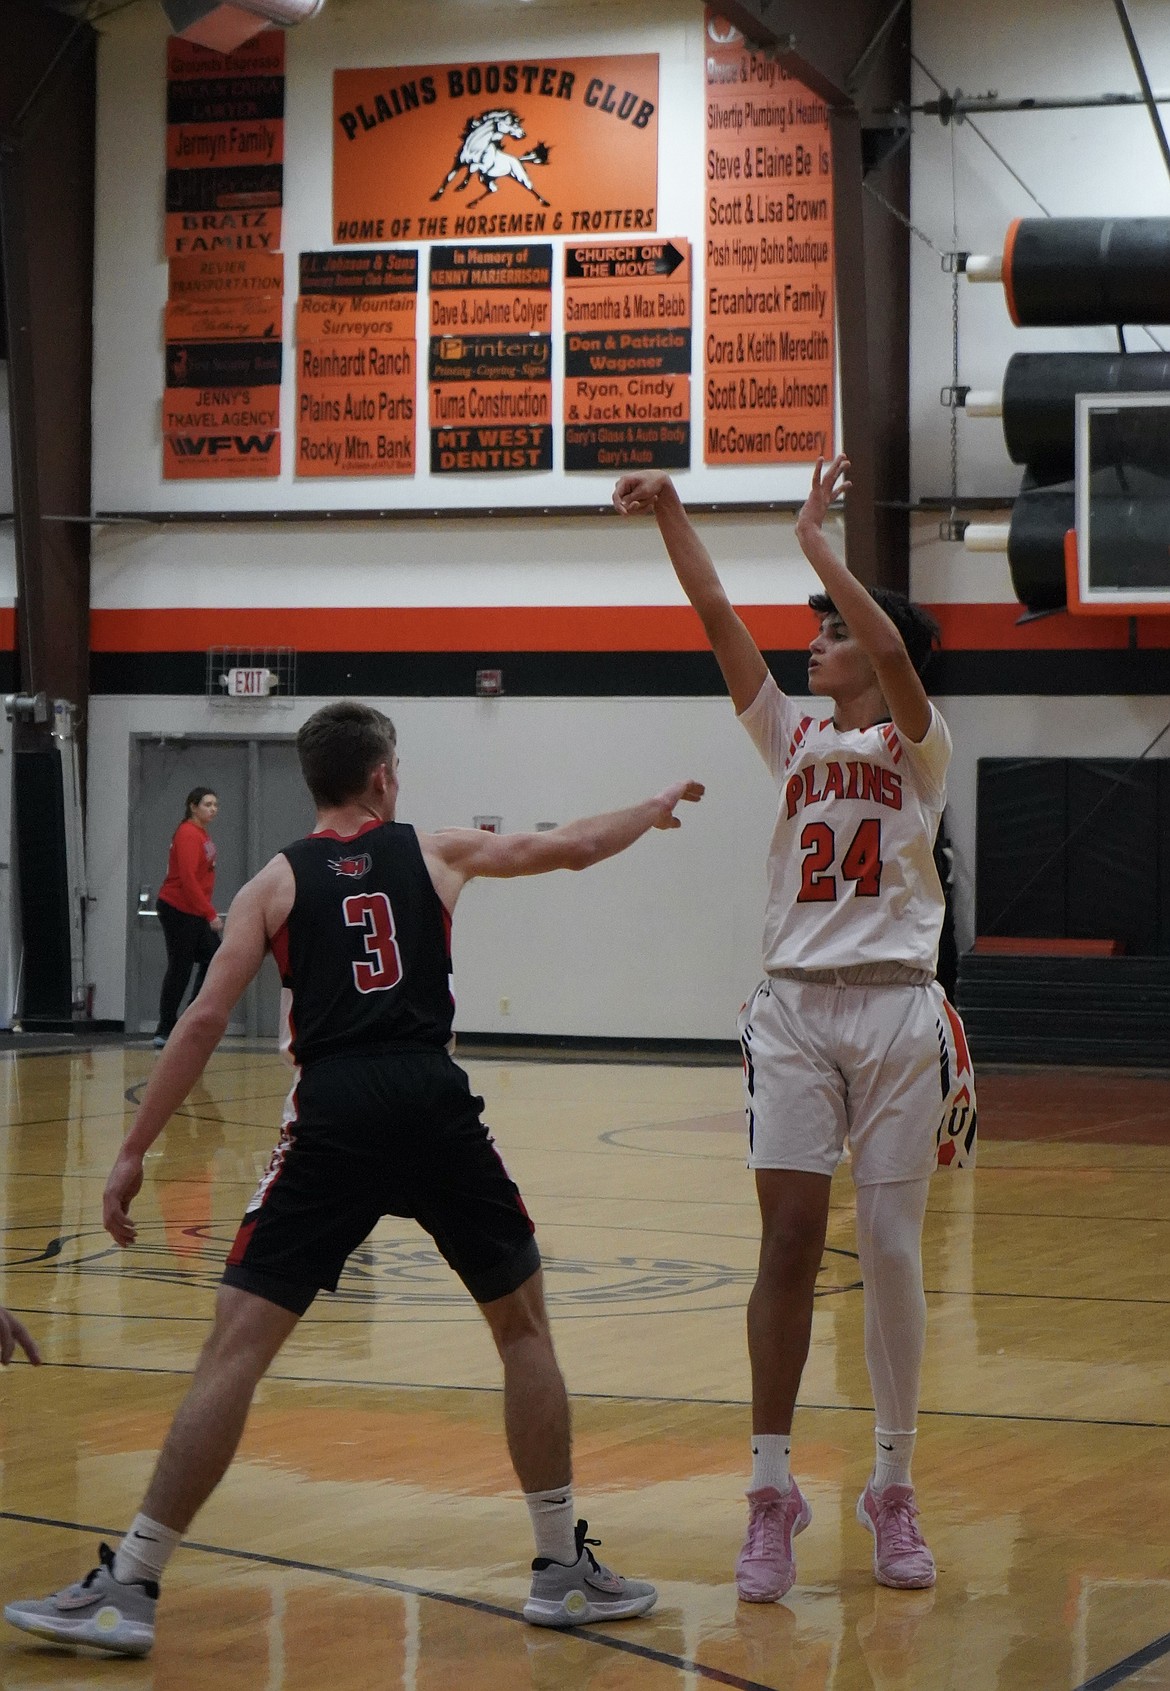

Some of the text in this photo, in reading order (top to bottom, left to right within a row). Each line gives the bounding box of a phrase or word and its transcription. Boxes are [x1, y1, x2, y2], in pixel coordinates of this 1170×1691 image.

[740, 56, 747, 83] &
[750, 55, 776, 88] Polly
[338, 64, 655, 141] PLAINS BOOSTER CLUB
[707, 97, 829, 134] Silvertip Plumbing & Heating
[175, 126, 275, 161] Jermyn Family
[707, 149, 741, 180] Steve
[744, 147, 752, 179] &
[756, 146, 793, 178] Elaine
[709, 193, 827, 226] Scott & Lisa Brown
[183, 212, 268, 231] BRATZ
[337, 208, 655, 240] HOME OF THE HORSEMEN & TROTTERS
[176, 232, 272, 253] FAMILY
[575, 246, 663, 262] CHURCH ON
[706, 235, 828, 272] Posh Hippy Boho Boutique
[373, 254, 383, 270] &
[387, 254, 416, 270] Sons
[453, 248, 529, 267] In Memory of
[581, 261, 656, 277] THE MOVE
[172, 277, 281, 292] TRANSPORTATION
[431, 269, 469, 285] KENNY
[301, 297, 414, 315] Rocky Mountain
[566, 292, 685, 321] Samantha & Max Bebb
[709, 283, 826, 319] Ercanbrack Family
[432, 297, 548, 329] Dave & JoAnne Colyer
[321, 320, 394, 338] Surveyors
[441, 339, 549, 362] Printery
[569, 333, 685, 352] Don & Patricia
[707, 330, 829, 364] Cora & Keith Meredith
[303, 347, 366, 378] Reinhardt
[368, 346, 411, 376] Ranch
[522, 363, 546, 378] Signs
[195, 390, 251, 407] JENNY'S
[627, 379, 674, 399] Cindy
[707, 375, 828, 410] Scott & Dede Johnson
[300, 391, 413, 422] Plains Auto Parts
[434, 386, 548, 419] Tuma Construction
[568, 401, 683, 420] & Jack Noland
[167, 410, 275, 428] TRAVEL AGENCY
[169, 432, 275, 455] VFW
[437, 427, 543, 448] MT WEST
[626, 427, 634, 443] &
[636, 427, 659, 442] Auto
[661, 425, 686, 444] Body
[707, 424, 826, 457] McGowan Grocery
[300, 434, 412, 465] Rocky Mtn. Bank
[440, 449, 542, 470] DENTIST
[598, 447, 653, 467] Gary's Auto
[235, 671, 262, 693] EXIT
[785, 761, 903, 820] PLAINS
[796, 818, 883, 903] 24
[342, 892, 403, 994] 3
